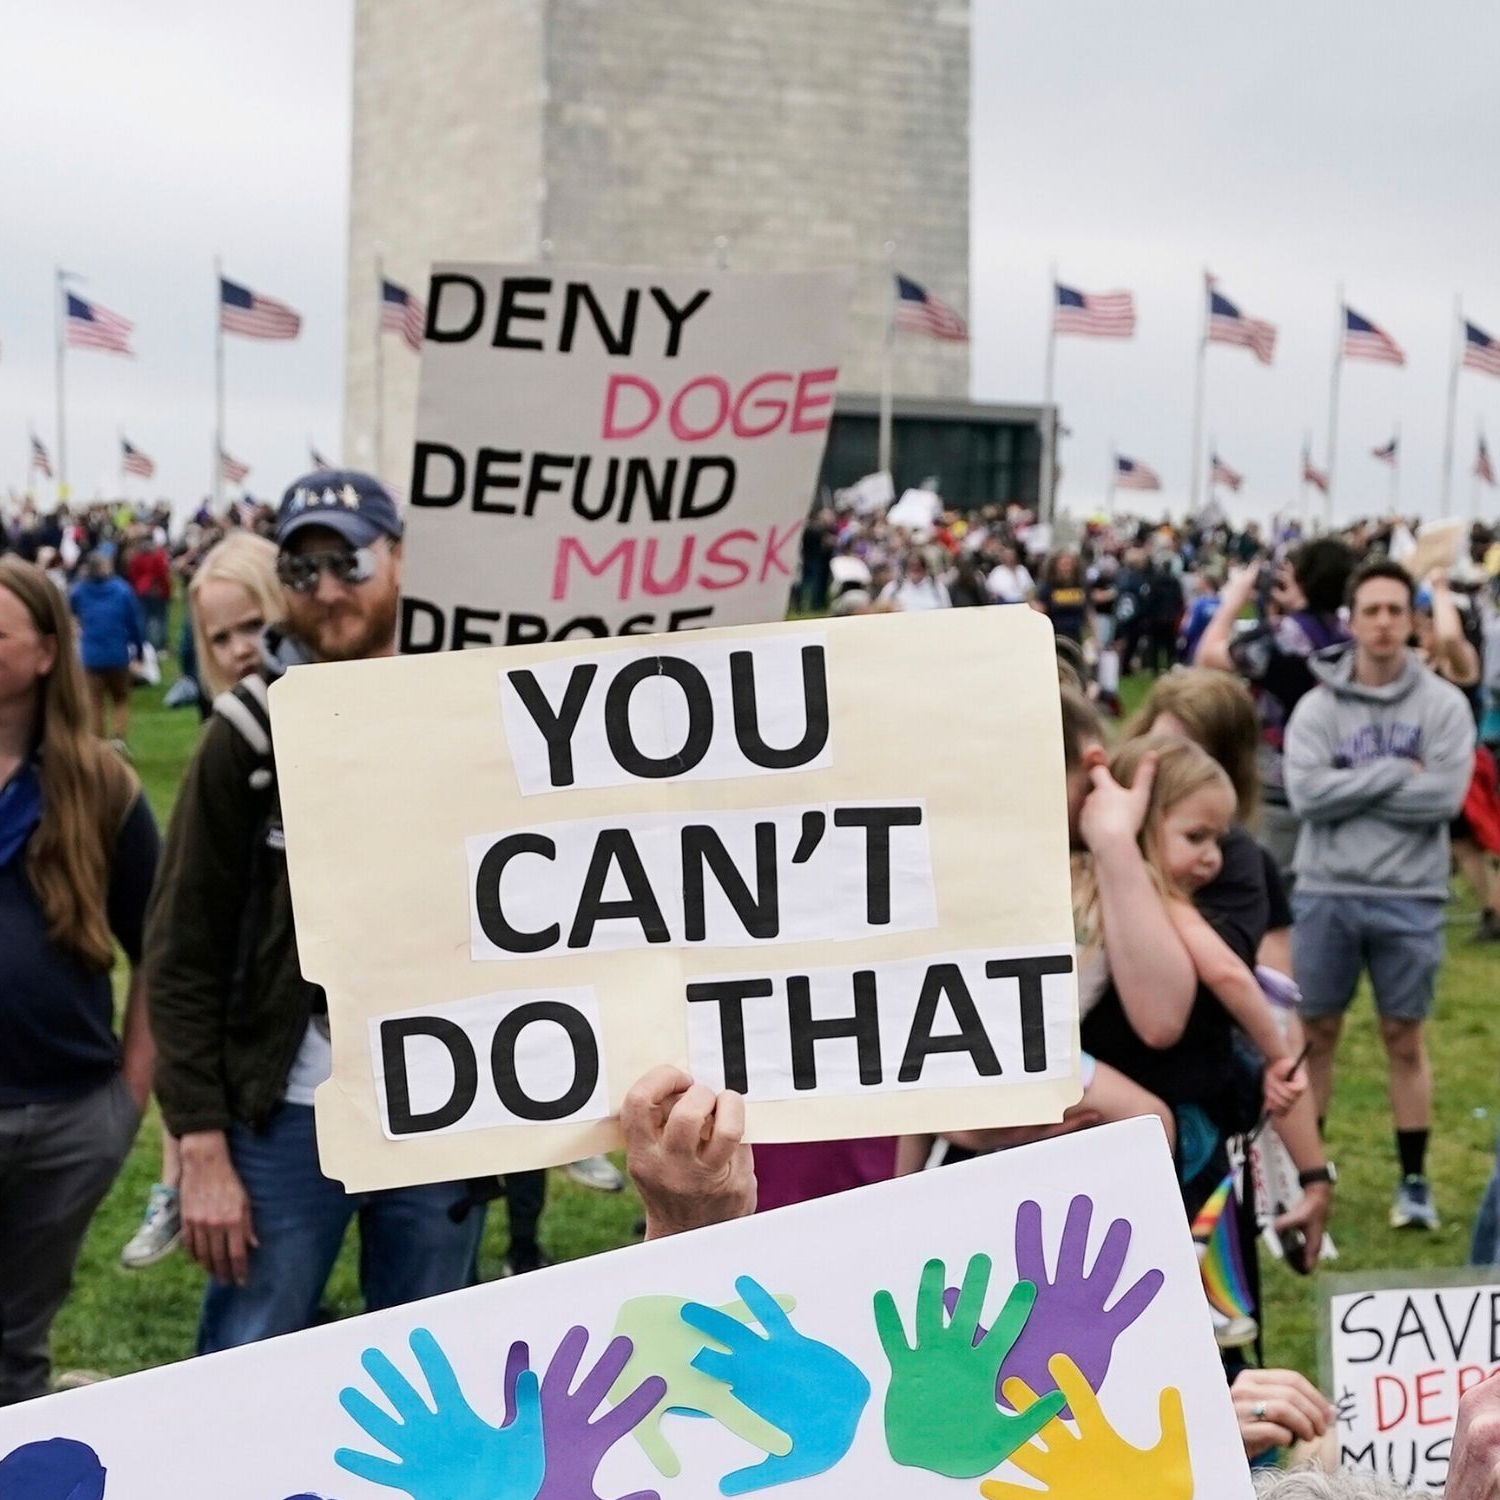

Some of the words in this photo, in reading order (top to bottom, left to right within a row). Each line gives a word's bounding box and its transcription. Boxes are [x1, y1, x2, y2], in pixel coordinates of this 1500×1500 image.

[425, 273, 711, 357] DENY
[601, 367, 839, 443] DOGE
[409, 442, 737, 523] DEFUND
[552, 520, 803, 602] MUSK
[507, 645, 830, 787] YOU
[475, 806, 922, 954] CAN'T
[380, 1001, 599, 1136] DO
[687, 954, 1074, 1096] THAT
